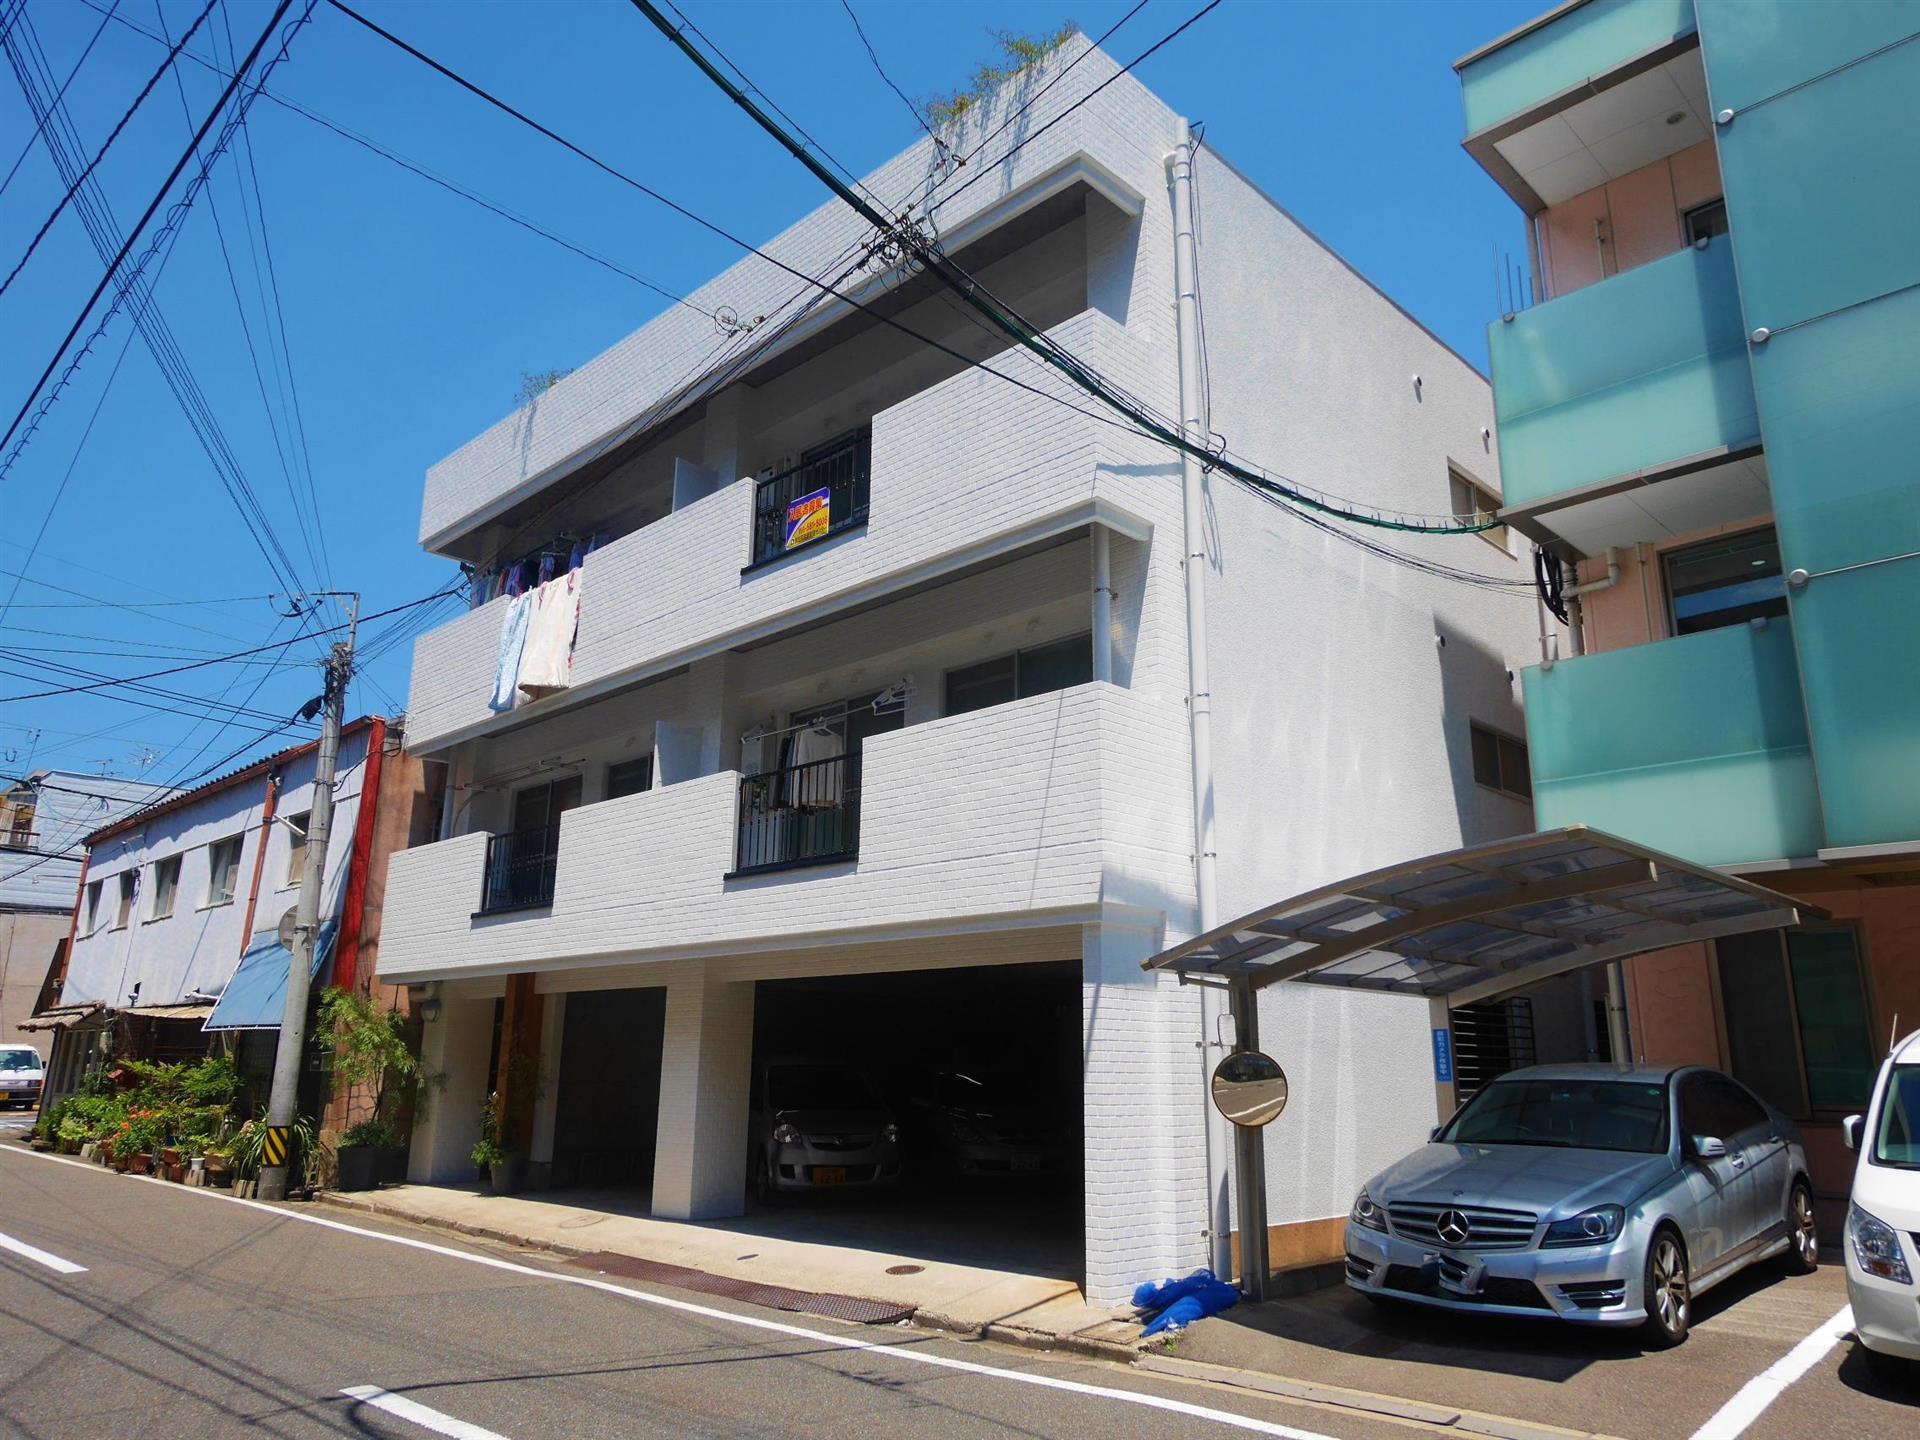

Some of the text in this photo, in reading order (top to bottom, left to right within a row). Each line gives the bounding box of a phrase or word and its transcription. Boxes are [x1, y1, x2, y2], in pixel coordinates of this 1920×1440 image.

[789, 496, 824, 521] 入居者募集
